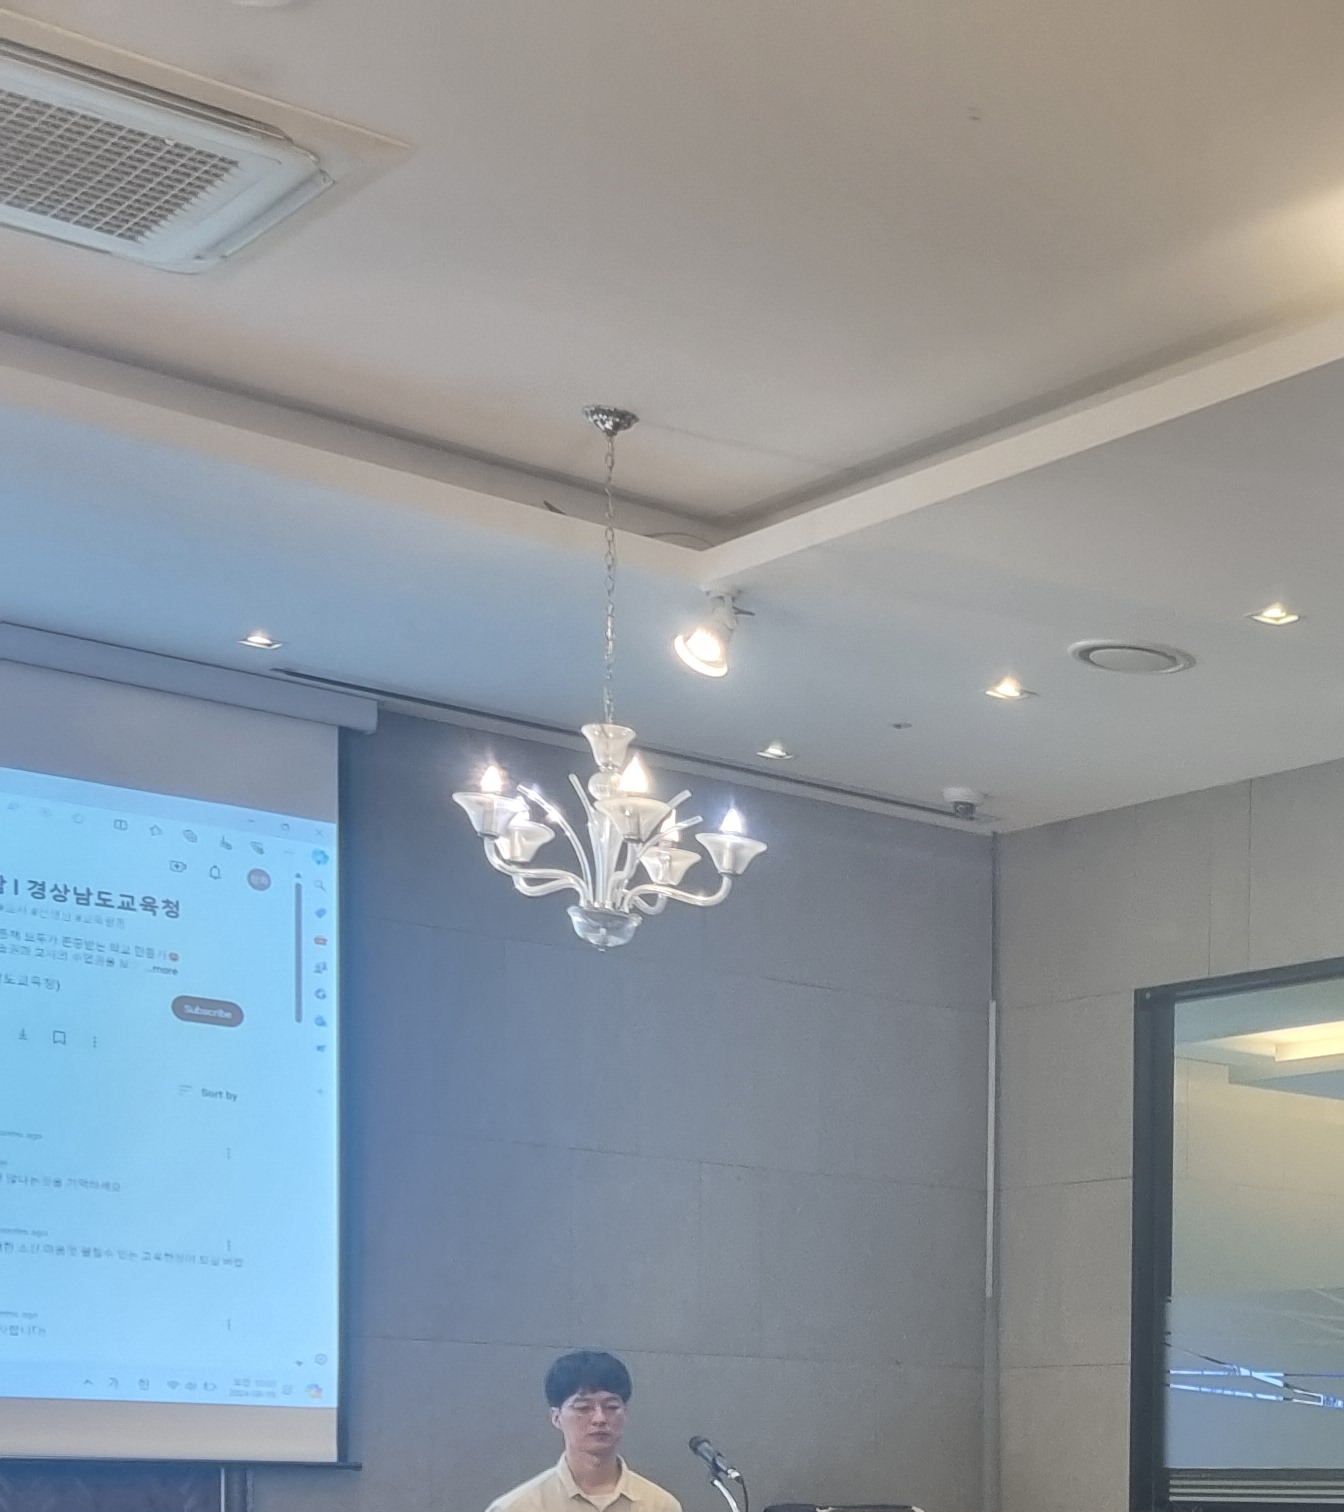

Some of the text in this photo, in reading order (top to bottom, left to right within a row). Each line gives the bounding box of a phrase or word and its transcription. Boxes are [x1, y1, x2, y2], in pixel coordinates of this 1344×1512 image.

[27, 879, 181, 919] 경상남도교육청
[0, 973, 61, 992] 도교육청)
[183, 1004, 232, 1019] Subscribe
[201, 1088, 238, 1101] Sort by
